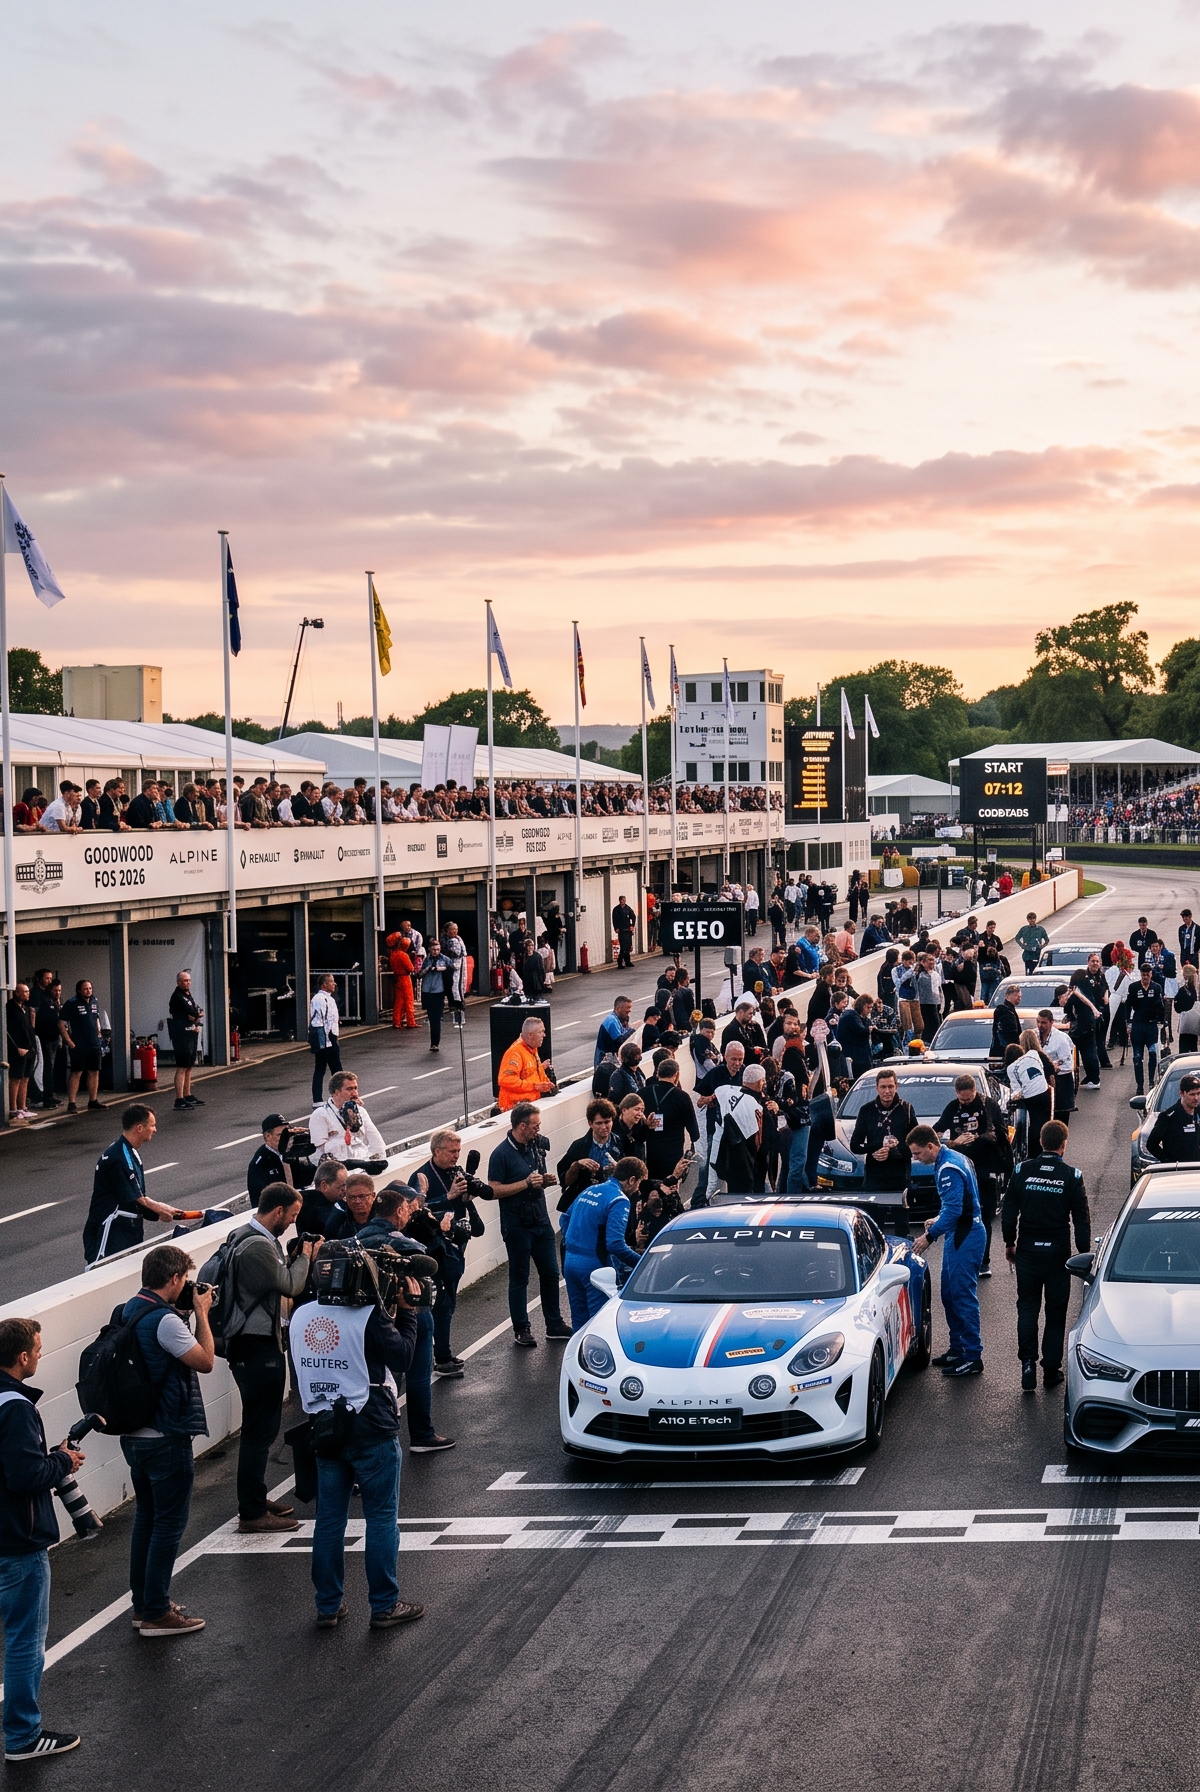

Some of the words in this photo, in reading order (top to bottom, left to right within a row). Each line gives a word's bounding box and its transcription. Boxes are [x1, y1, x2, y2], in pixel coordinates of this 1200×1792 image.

[984, 762, 1024, 773] START
[984, 782, 1023, 795] 07:12
[84, 844, 154, 865] GOODWOOD
[169, 849, 218, 864] ALPINE
[249, 852, 281, 864] RENAULT
[95, 870, 116, 888] FOS
[119, 868, 146, 887] 2026
[685, 1230, 815, 1241] ALPINE
[301, 1357, 349, 1370] REUTERS
[656, 1398, 734, 1406] ALPINE
[658, 1417, 685, 1425] A110
